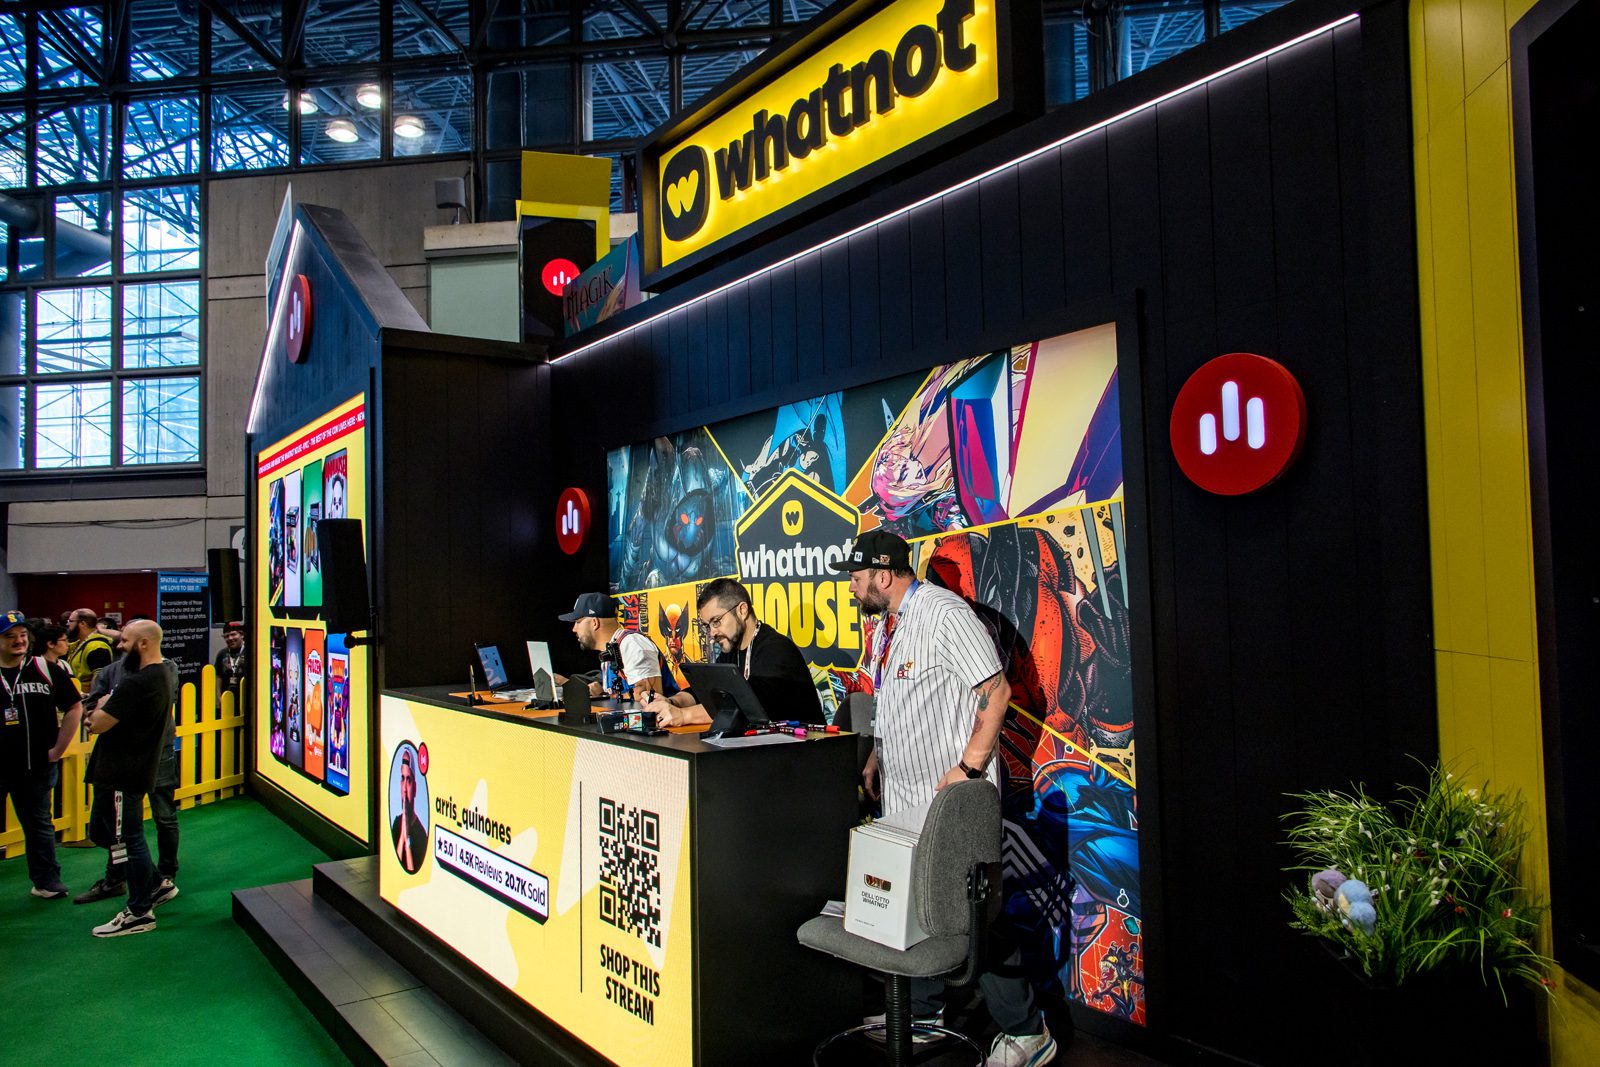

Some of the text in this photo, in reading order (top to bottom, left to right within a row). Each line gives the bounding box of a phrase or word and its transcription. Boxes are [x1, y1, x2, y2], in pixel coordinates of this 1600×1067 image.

[713, 0, 977, 201] whatnot
[435, 796, 511, 845] arris_quinones
[443, 839, 546, 908] 5.0 4.5K Reviews 20.7K Sold
[862, 898, 889, 910] WHATNOT
[600, 943, 660, 998] SHOP THIS
[605, 975, 655, 1026] STREAM
